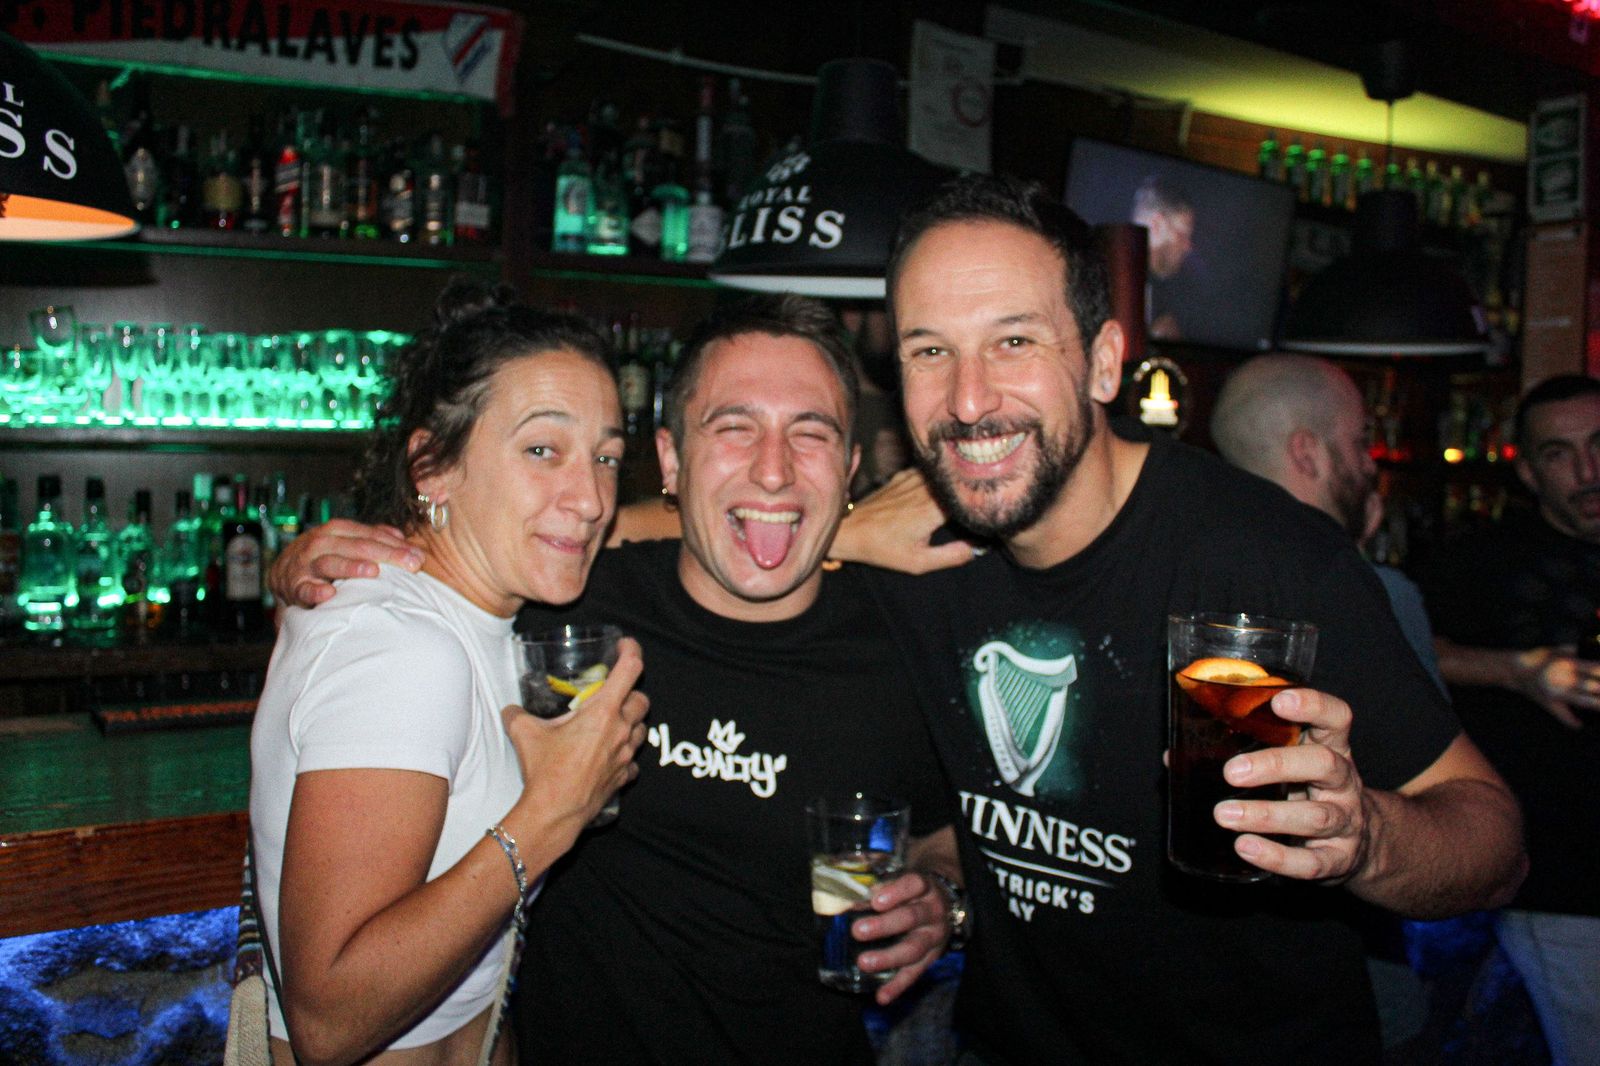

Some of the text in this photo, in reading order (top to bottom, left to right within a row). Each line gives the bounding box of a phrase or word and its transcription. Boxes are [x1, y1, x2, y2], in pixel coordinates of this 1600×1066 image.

[73, 0, 419, 69] PIEDRALAVES
[722, 205, 846, 249] LISS
[987, 862, 1095, 914] TRICK'S
